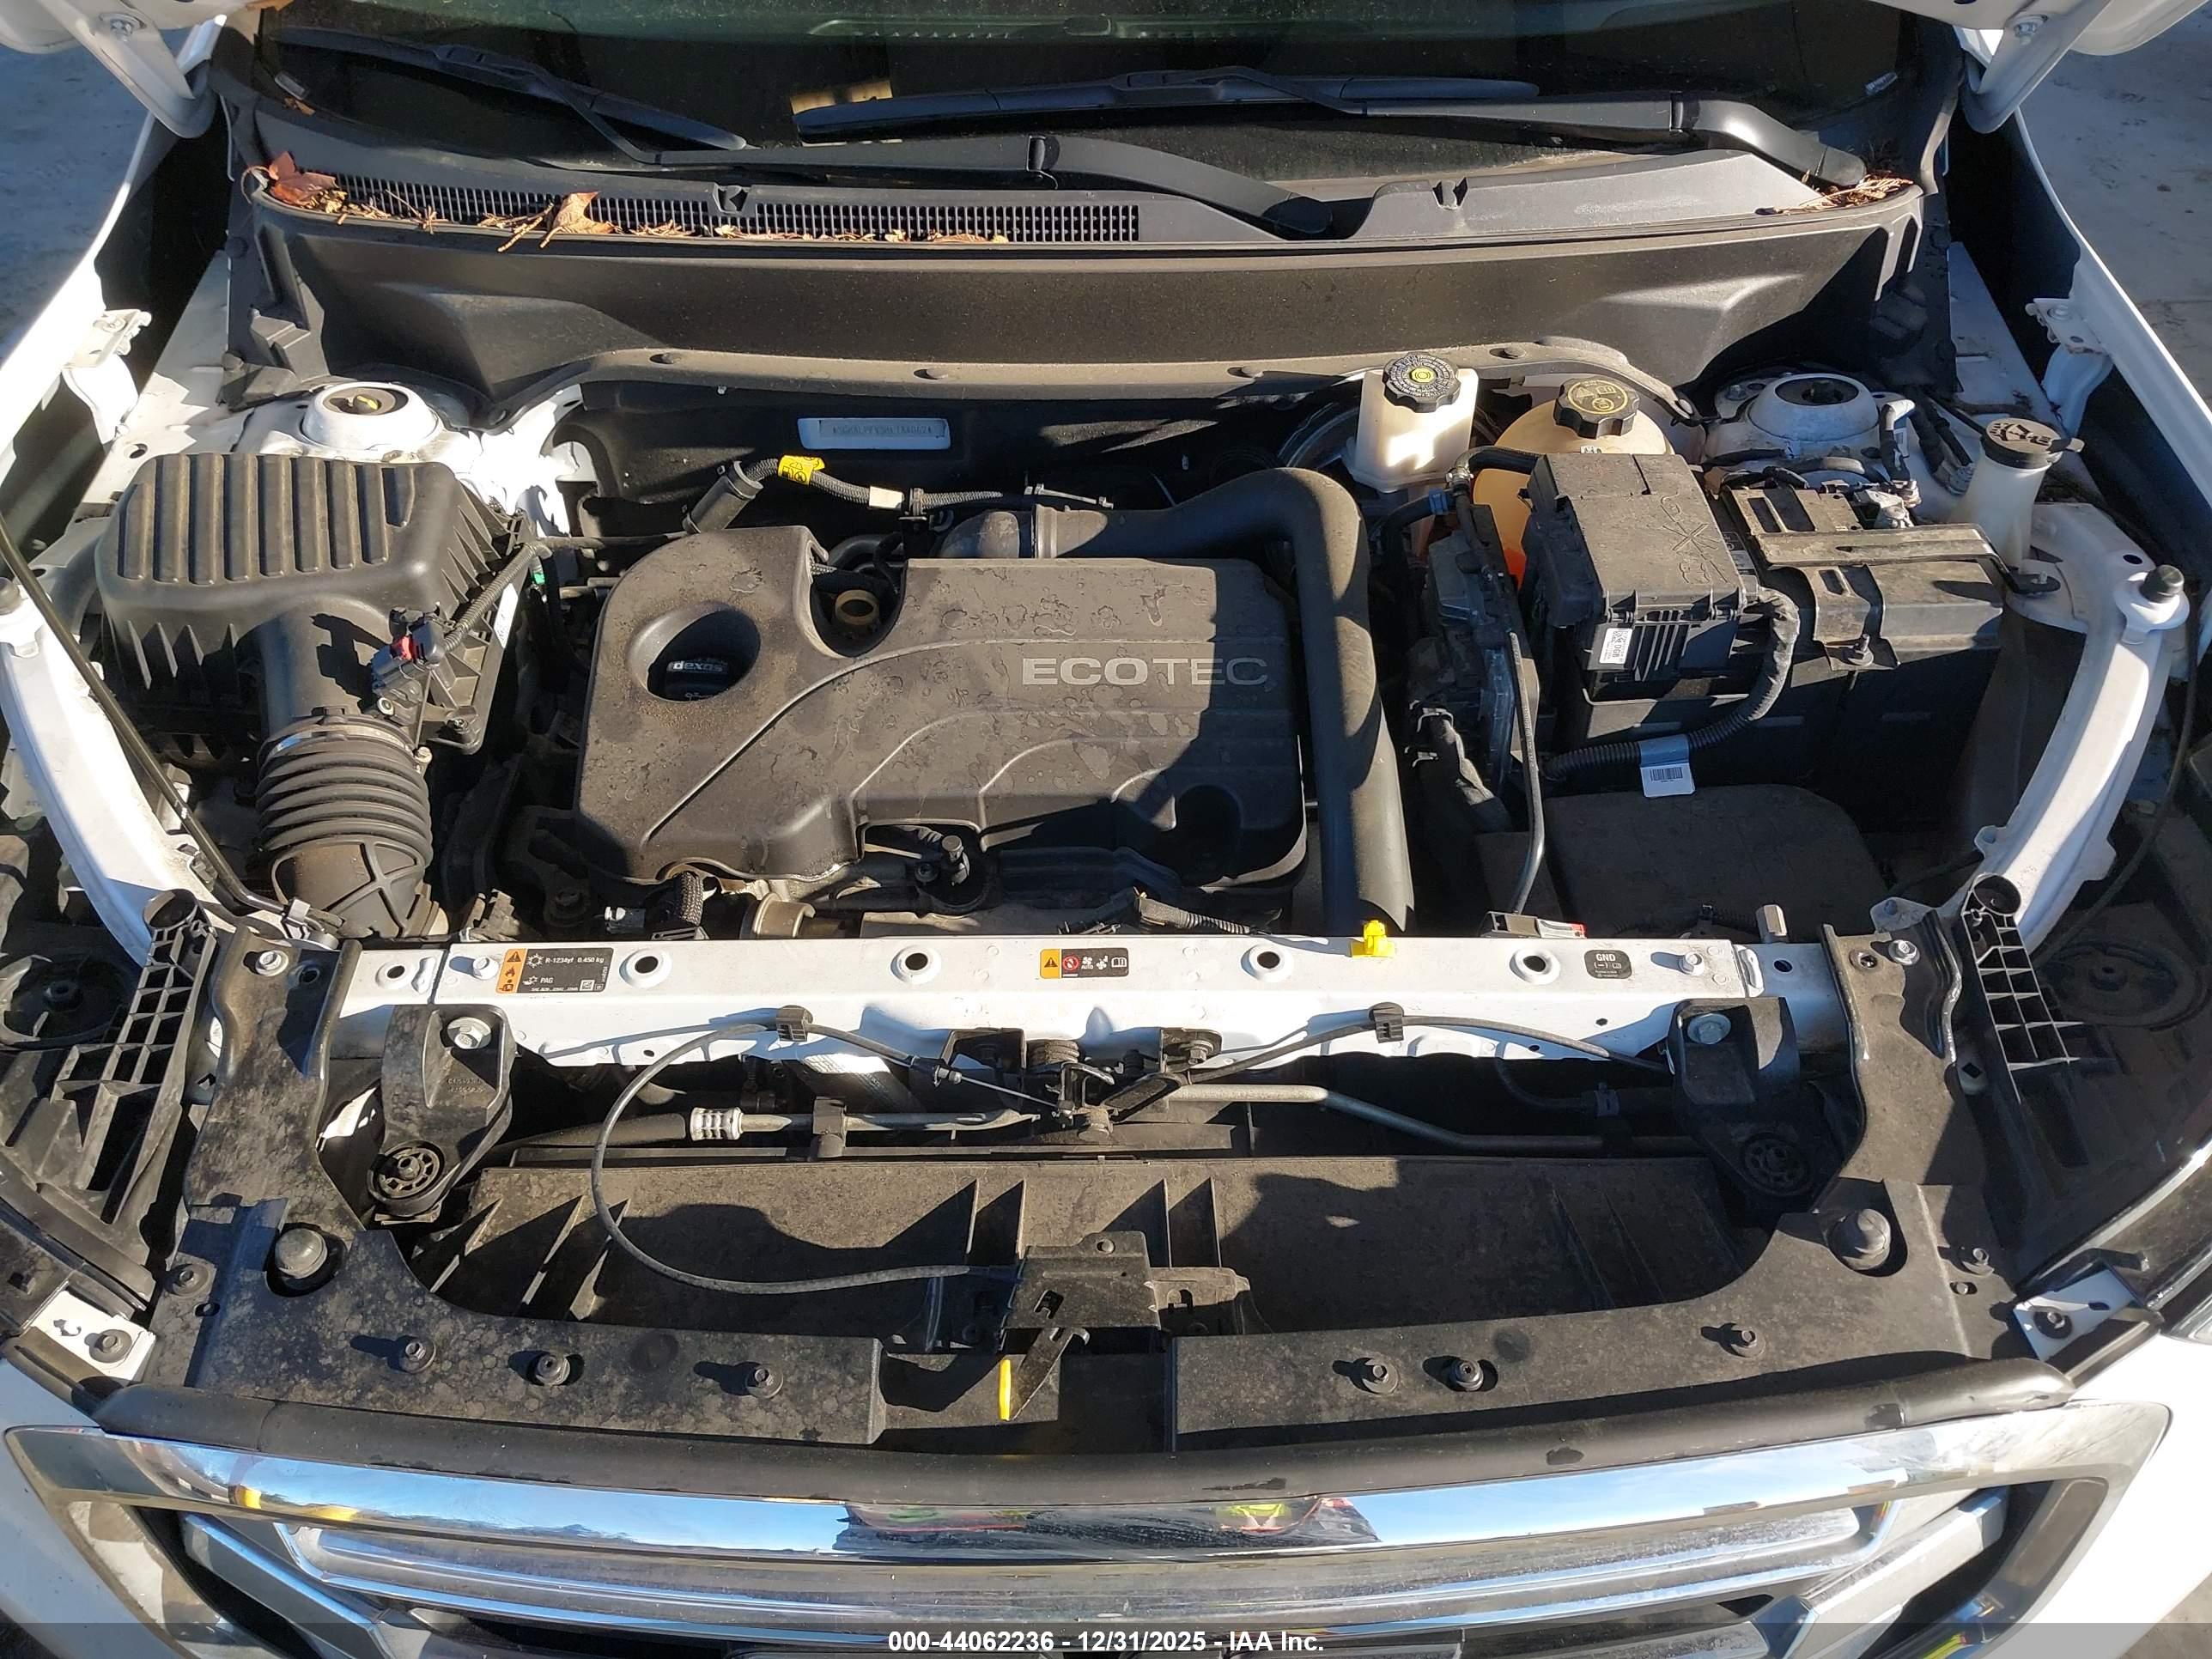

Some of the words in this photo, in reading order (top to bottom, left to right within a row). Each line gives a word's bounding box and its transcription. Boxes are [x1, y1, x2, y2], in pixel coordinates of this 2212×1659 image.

[672, 660, 722, 672] dexos
[1022, 658, 1268, 685] ECOTEC
[1595, 953, 1616, 962] GND
